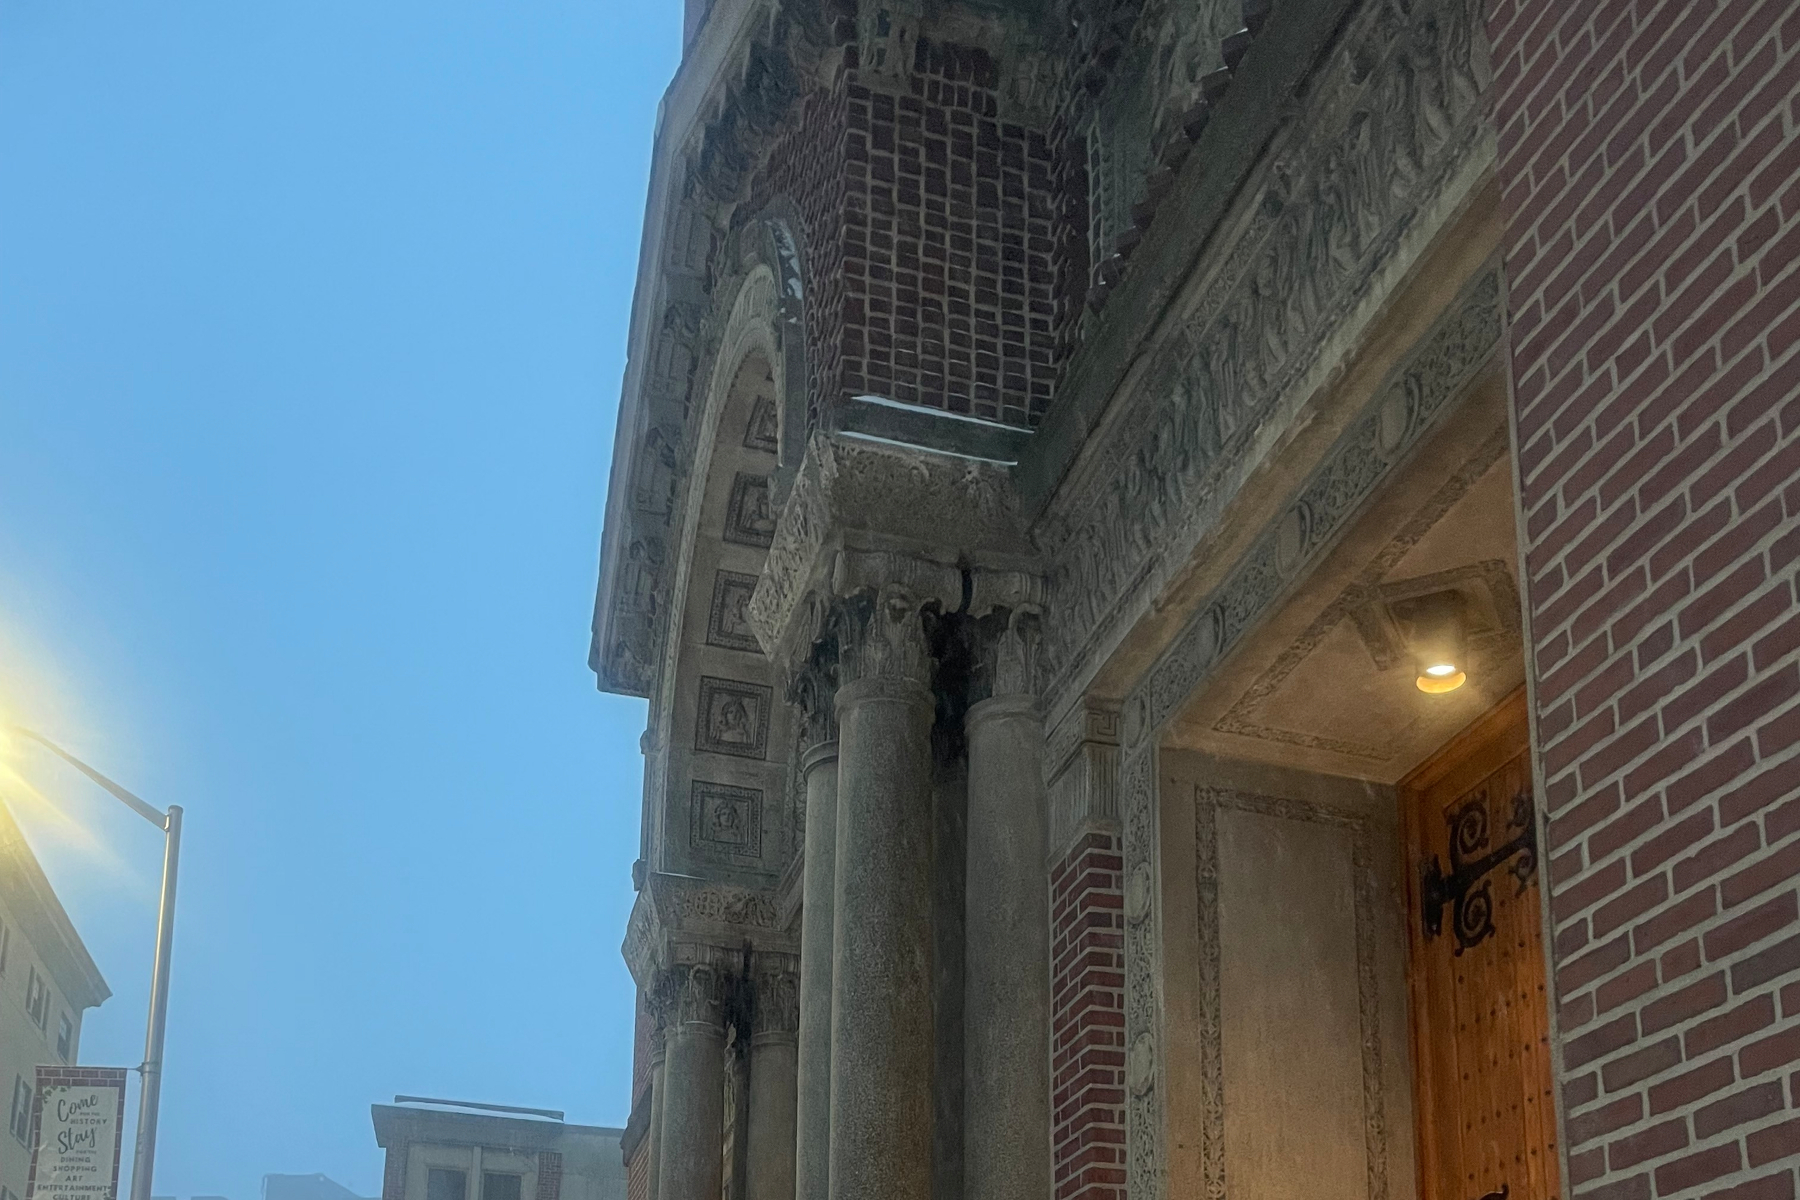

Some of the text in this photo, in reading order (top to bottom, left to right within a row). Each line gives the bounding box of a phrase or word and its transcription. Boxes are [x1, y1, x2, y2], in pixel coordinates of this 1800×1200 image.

[57, 1094, 98, 1122] Come
[57, 1127, 97, 1154] Stay
[37, 1184, 108, 1192] ENTERTAINMENT
[52, 1193, 91, 1200] CULTURE
